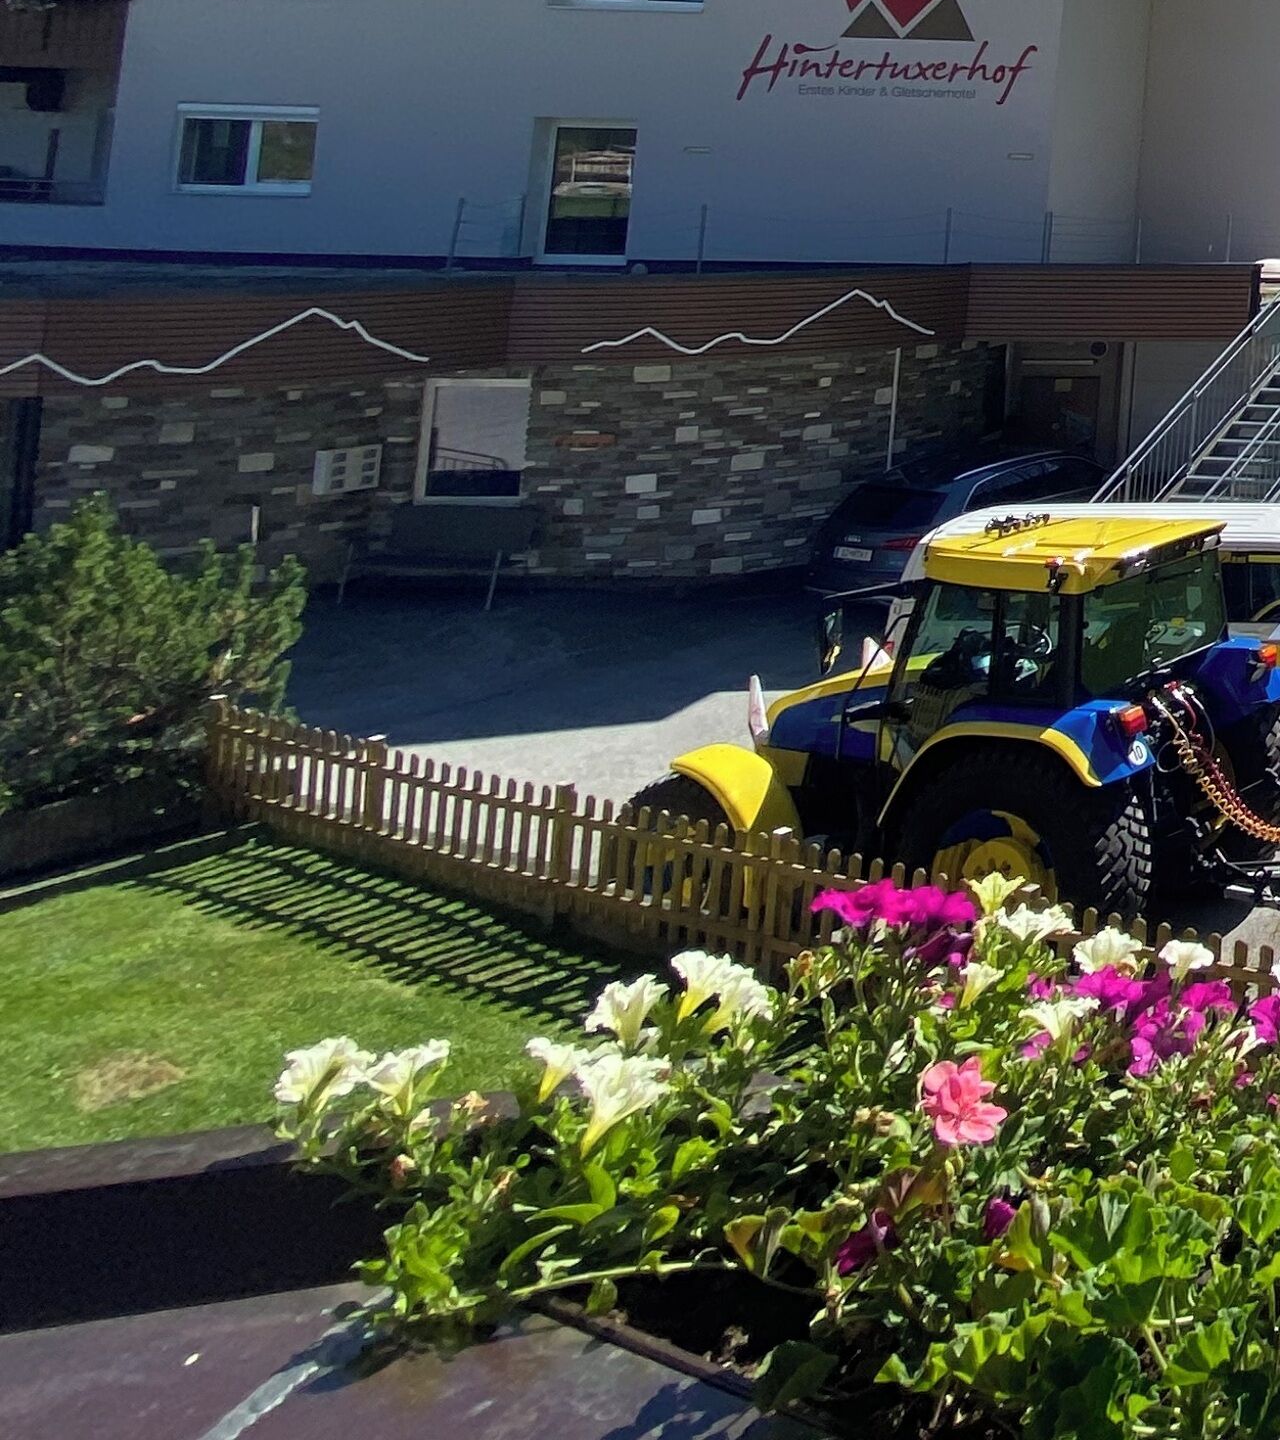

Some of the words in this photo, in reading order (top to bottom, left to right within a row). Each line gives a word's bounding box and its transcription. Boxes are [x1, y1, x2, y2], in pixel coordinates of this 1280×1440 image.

[736, 33, 1038, 105] Hintertuxerhof
[797, 83, 835, 96] Erstes
[838, 85, 876, 97] Kinder
[879, 86, 888, 97] &
[1132, 745, 1144, 761] 10
